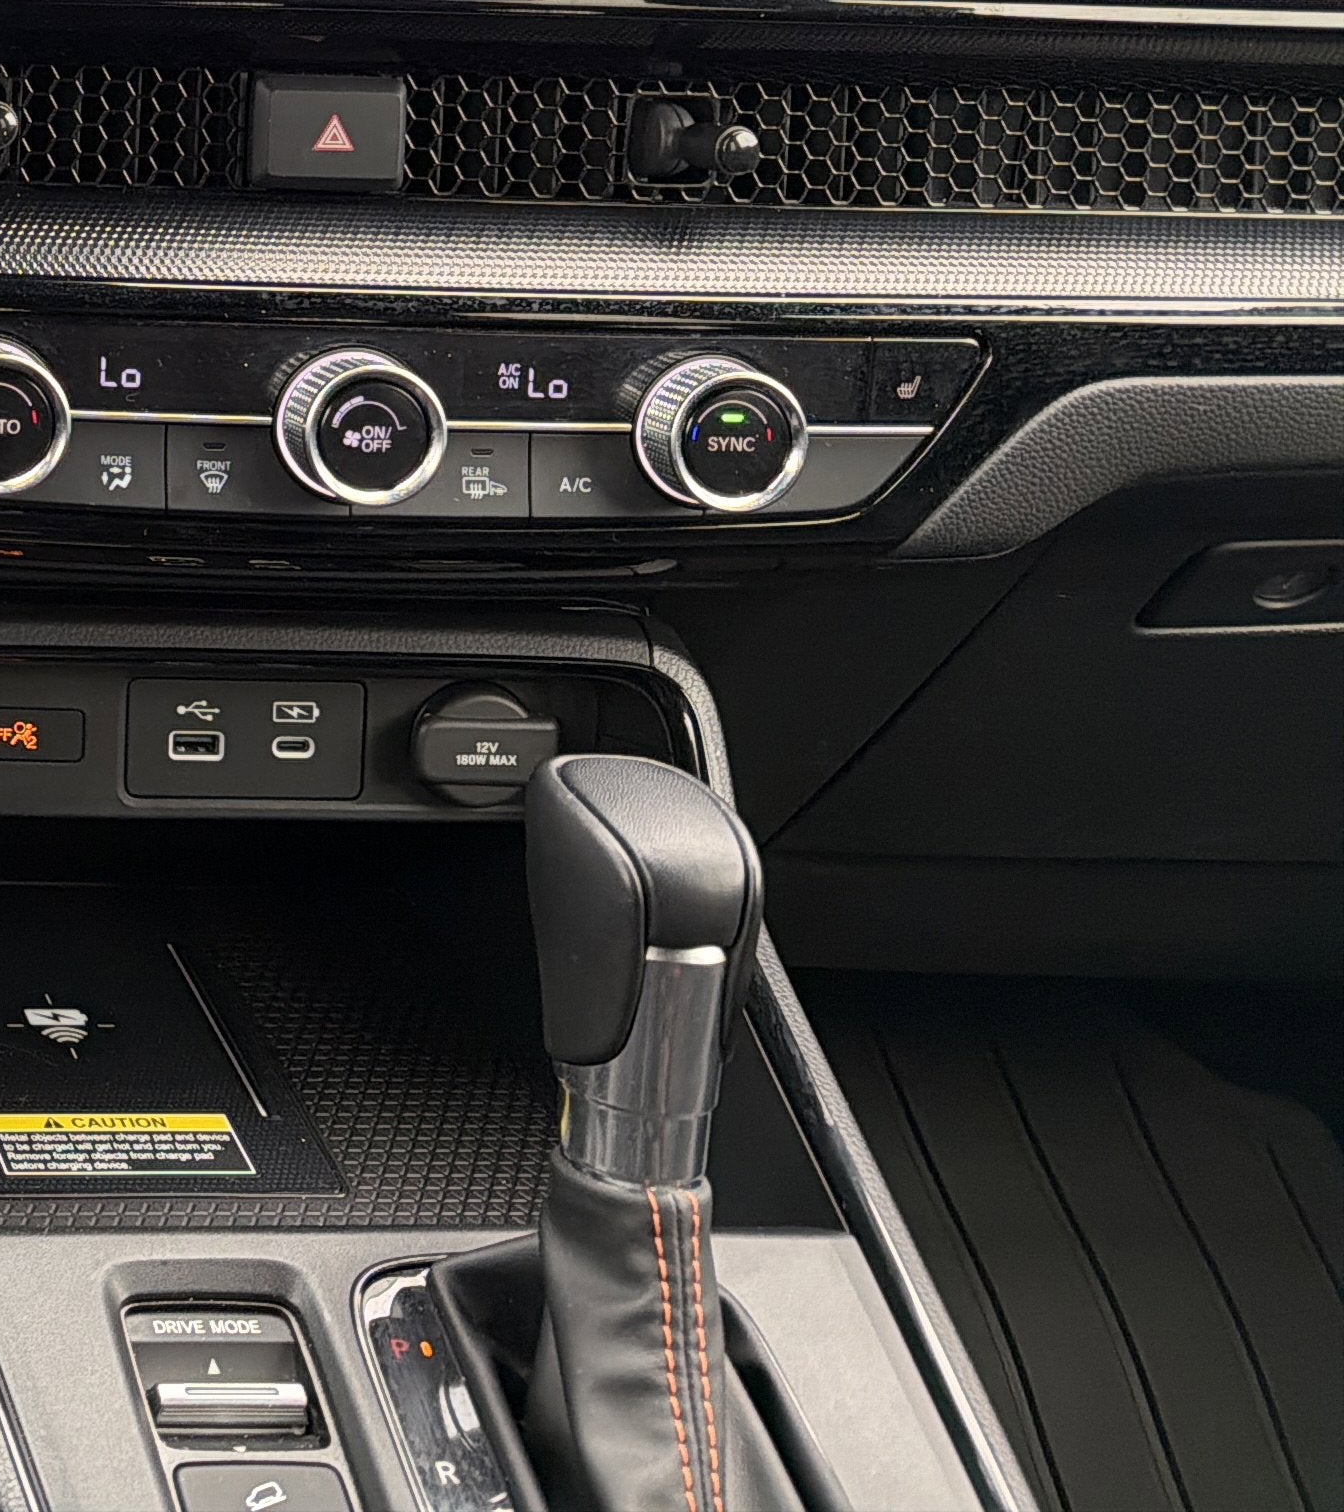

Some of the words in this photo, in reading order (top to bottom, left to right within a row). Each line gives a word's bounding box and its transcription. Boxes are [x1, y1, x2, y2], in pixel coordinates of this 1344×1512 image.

[100, 356, 141, 388] Lo
[498, 363, 521, 377] A/C
[499, 377, 519, 389] ON
[528, 367, 568, 398] Lo
[362, 426, 391, 440] ON/
[362, 440, 392, 453] OFF
[707, 437, 755, 453] SYNC
[100, 455, 132, 467] MODE
[197, 460, 231, 472] FRONT
[461, 466, 490, 477] REAR
[560, 477, 592, 493] A/C
[475, 742, 500, 754] 12V
[456, 755, 487, 766] 180W
[489, 755, 517, 766] MAX
[71, 1117, 168, 1128] CAUTION
[0, 1133, 28, 1141] Metal
[30, 1133, 67, 1143] objects
[69, 1133, 113, 1141] between
[115, 1133, 151, 1143] charge
[153, 1133, 172, 1143] pad
[174, 1133, 194, 1141] and
[196, 1133, 230, 1141] device
[32, 1143, 74, 1152] charged
[7, 1152, 51, 1160] Remove
[53, 1152, 89, 1162] foreign
[91, 1152, 128, 1162] objects
[130, 1152, 154, 1160] from
[155, 1152, 192, 1162] charge
[194, 1152, 214, 1162] pad
[11, 1161, 45, 1169] before
[47, 1161, 92, 1171] charging
[152, 1320, 205, 1334] DRIVE
[209, 1320, 262, 1334] MODE
[390, 1338, 410, 1361] P
[434, 1460, 461, 1485] R
